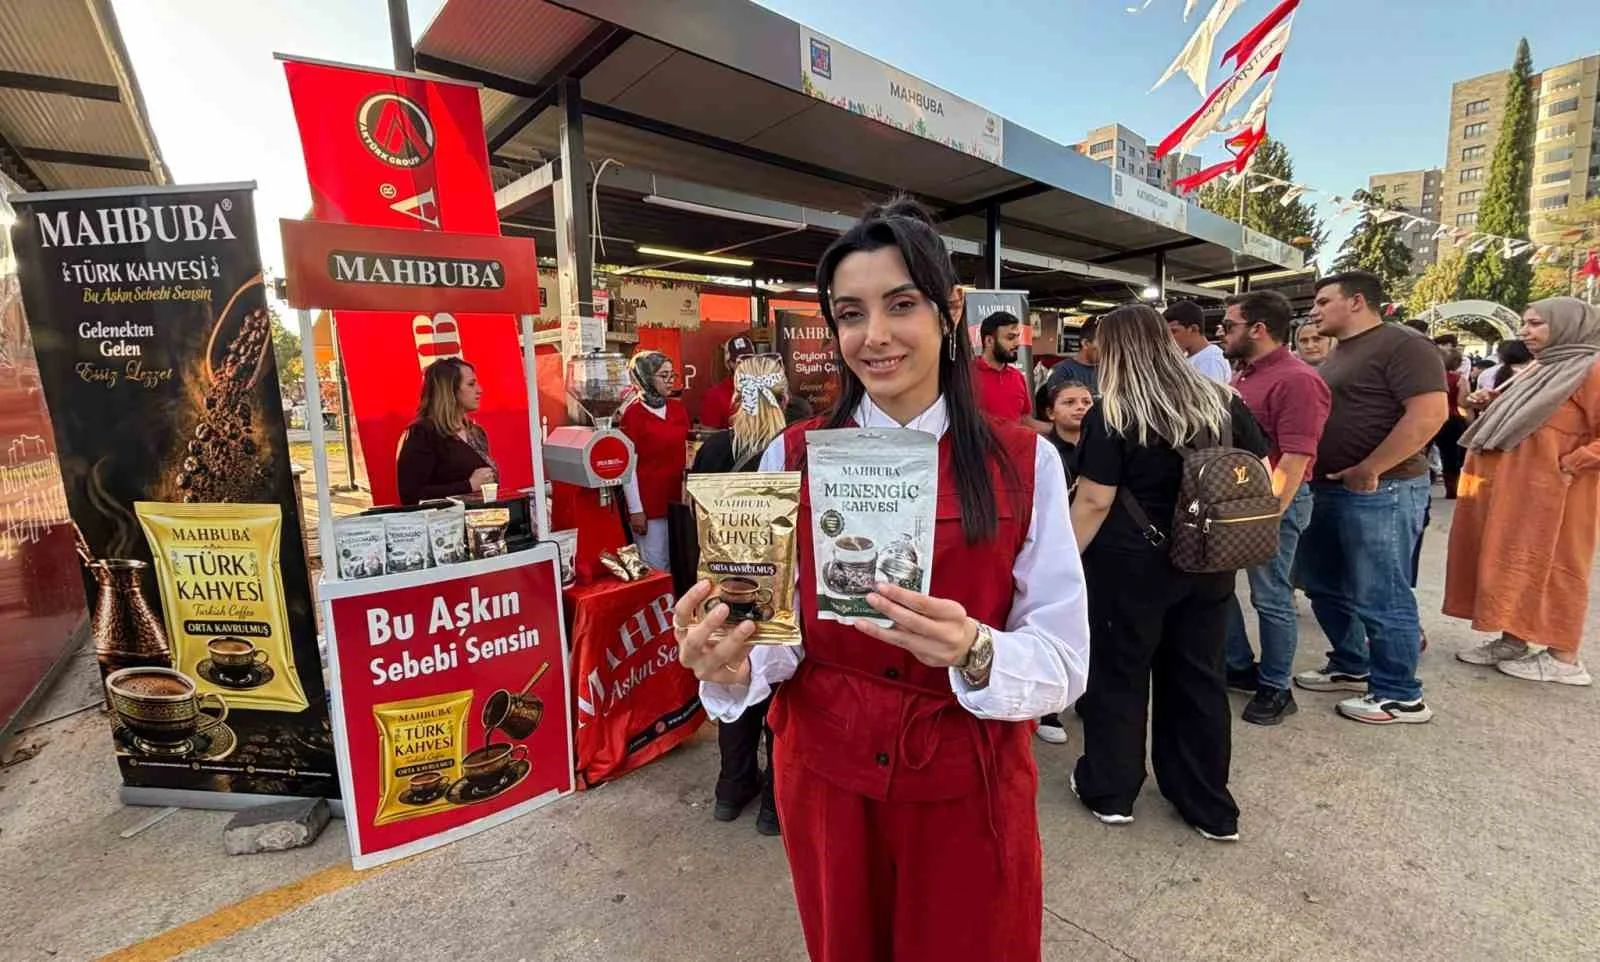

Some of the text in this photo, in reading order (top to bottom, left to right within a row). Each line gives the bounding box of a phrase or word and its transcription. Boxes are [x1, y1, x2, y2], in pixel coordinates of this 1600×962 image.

[890, 81, 945, 118] MAHBUBA
[388, 156, 420, 166] GROUP
[71, 255, 209, 284] TÜRK KAHVESİ
[83, 287, 100, 304] Bu
[133, 285, 170, 302] Sebebi
[171, 284, 213, 302] Sensin
[78, 321, 154, 339] Gelenekten
[99, 340, 142, 357] Gelen
[792, 351, 827, 362] Ceylon
[795, 363, 823, 375] Siyah
[842, 466, 900, 477] MAHBUBA
[824, 482, 919, 503] MENENGİÇ
[713, 499, 771, 509] MAHBUBA
[841, 500, 899, 513] KAHVESİ
[172, 527, 250, 542] MAHBUBA
[184, 551, 246, 576] TÜRK
[710, 563, 729, 571] ORTA
[176, 578, 265, 602] KAHVESİ
[192, 603, 255, 619] Turkish Coffee
[366, 587, 520, 646] Bu Aşkın
[188, 623, 269, 636] ORTA KAVRULMUŞ
[370, 625, 540, 686] Sebebi Sensin
[404, 722, 445, 741] TÜRK
